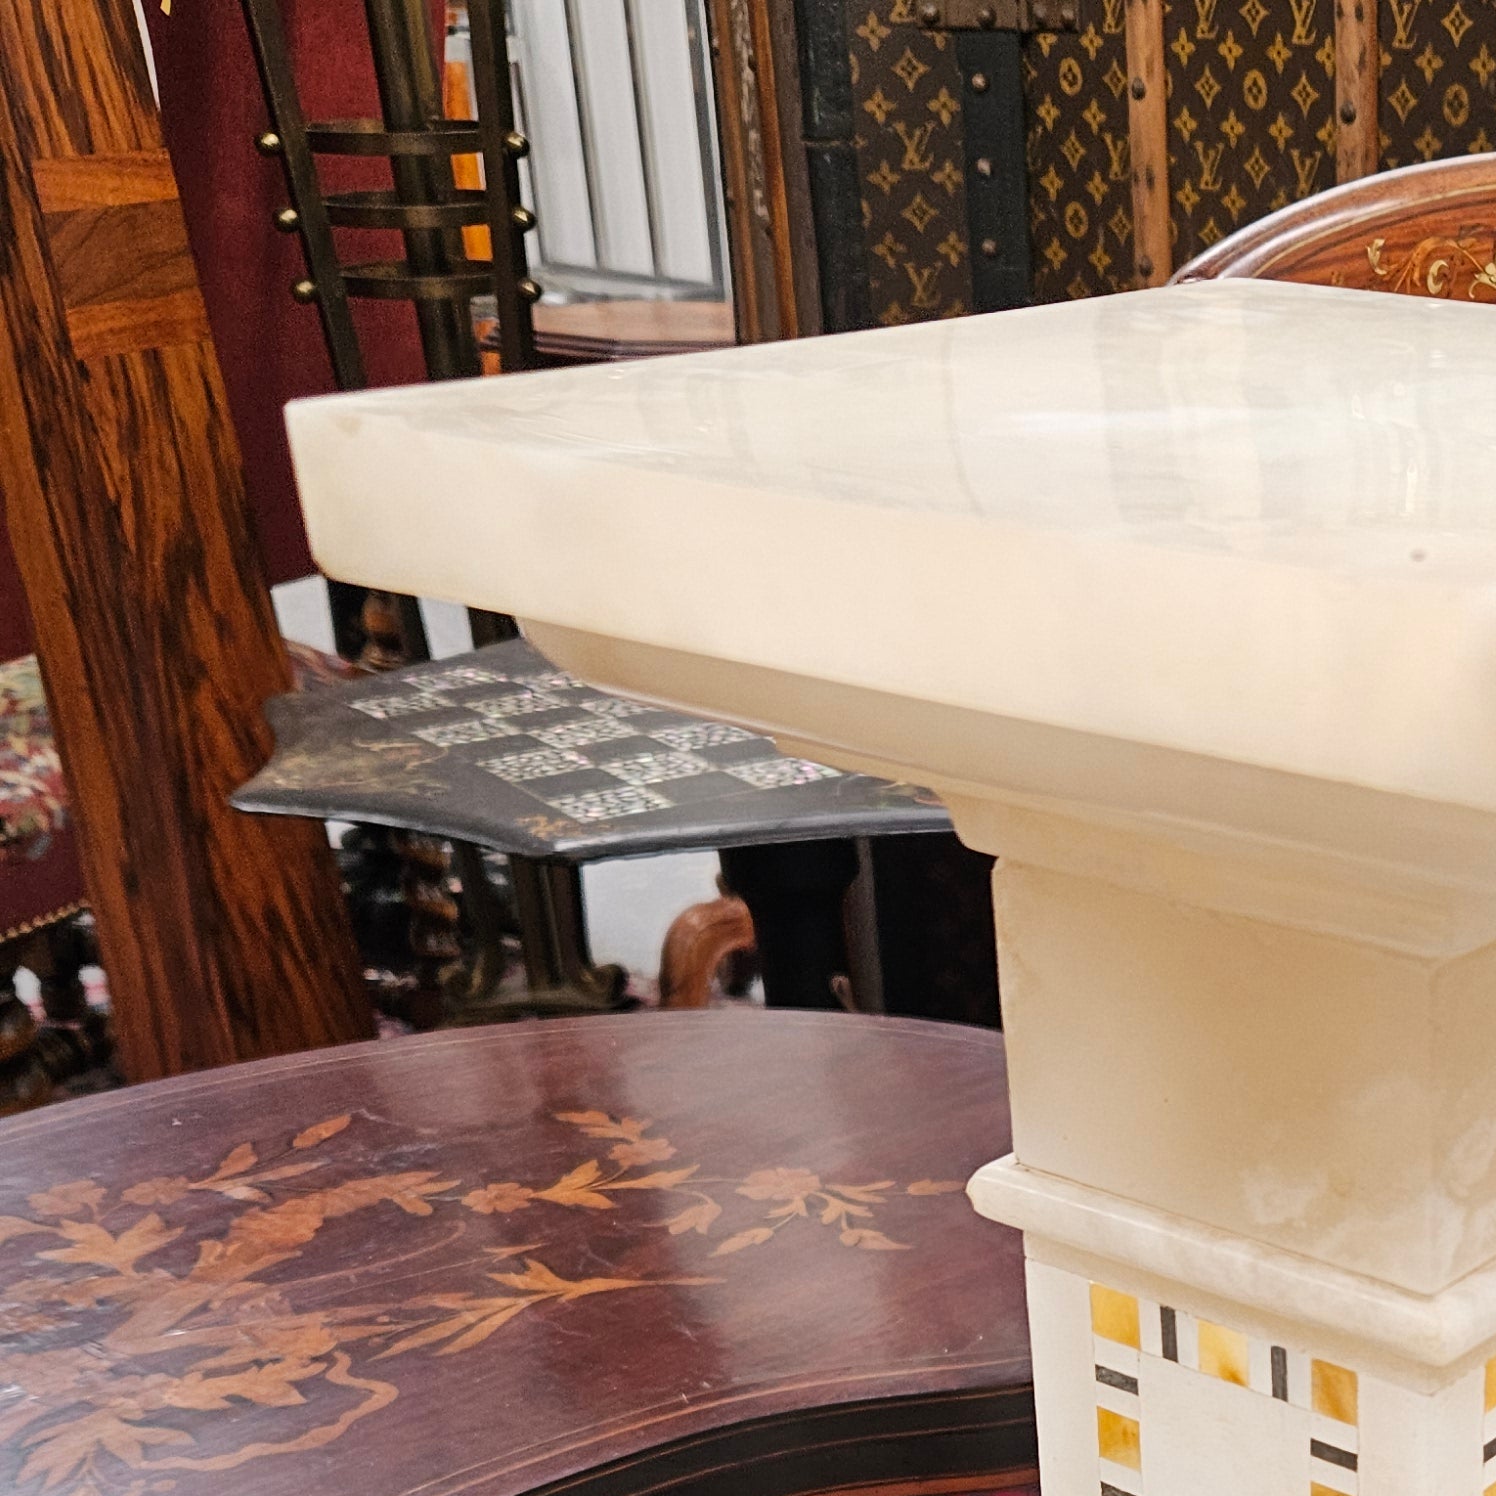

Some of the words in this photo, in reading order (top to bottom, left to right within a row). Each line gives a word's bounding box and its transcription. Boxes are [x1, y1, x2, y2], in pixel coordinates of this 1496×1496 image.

[1391, 0, 1418, 49] LV
[892, 119, 936, 171] LV
[1194, 141, 1224, 190] LV
